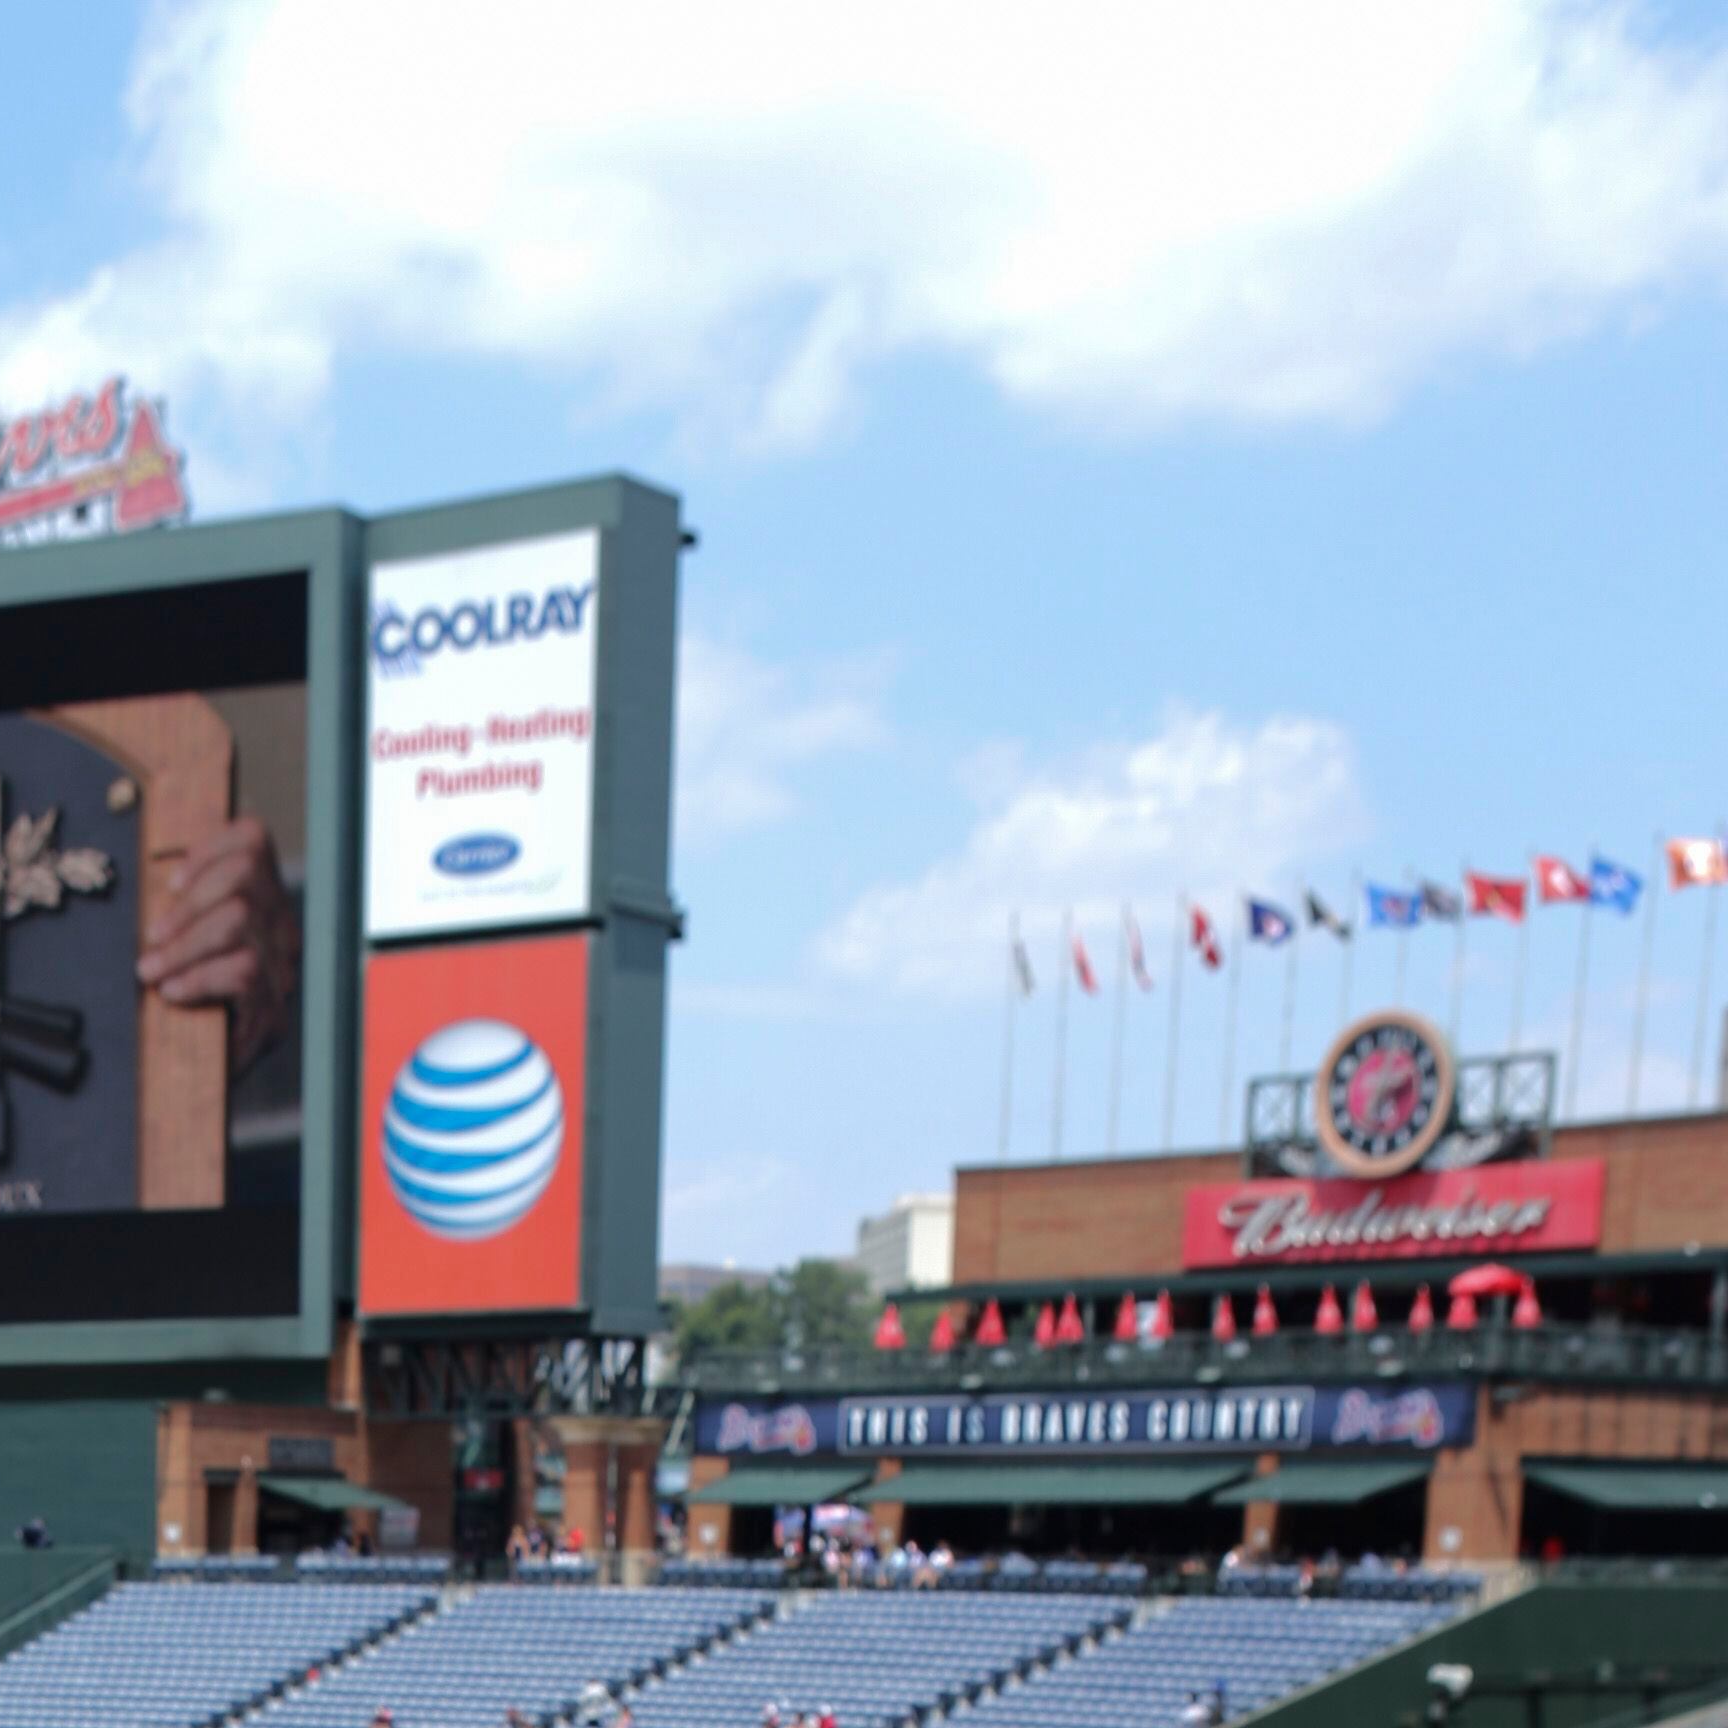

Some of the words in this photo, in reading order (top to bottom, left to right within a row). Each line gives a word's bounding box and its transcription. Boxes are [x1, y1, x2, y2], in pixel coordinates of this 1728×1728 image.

[373, 580, 596, 661] COOLRAY
[417, 762, 543, 797] Plumbing
[1218, 1190, 1551, 1258] Budweiser
[849, 1406, 928, 1447] THIS
[947, 1404, 985, 1445] IS
[1001, 1400, 1130, 1444] BRAVES
[1147, 1397, 1303, 1442] COUNTRY
